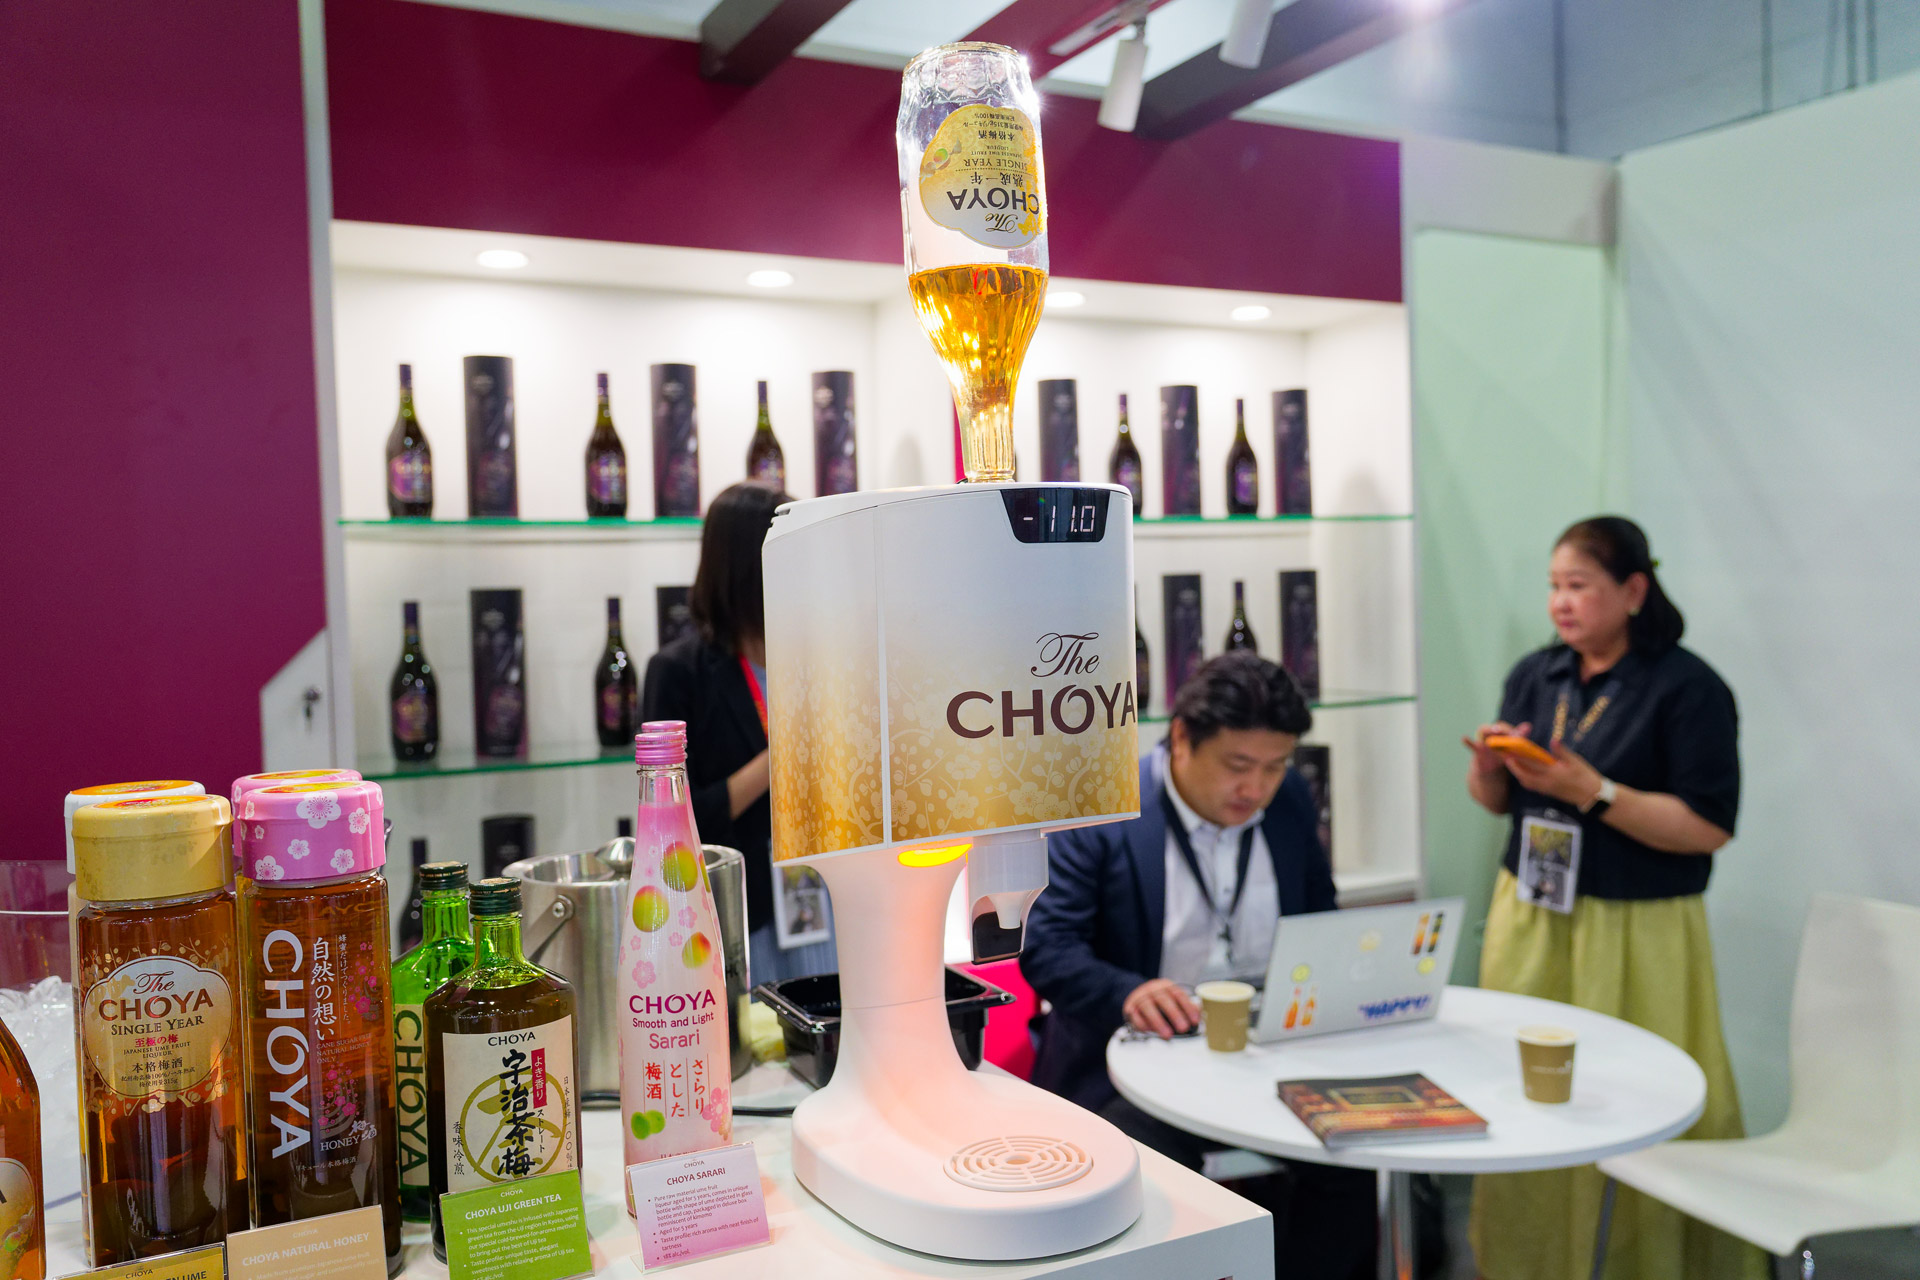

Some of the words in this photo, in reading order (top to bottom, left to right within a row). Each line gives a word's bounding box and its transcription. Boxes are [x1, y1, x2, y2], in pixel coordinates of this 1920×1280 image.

[963, 158, 991, 168] YEAR
[969, 171, 1024, 188] 熟成一年
[946, 187, 1039, 215] CHOYA
[984, 212, 1018, 233] The
[1030, 632, 1100, 678] The
[946, 680, 1137, 739] CHOYA
[133, 970, 175, 994] The
[310, 937, 337, 1041] 自然の想い
[98, 988, 214, 1021] CHOYA
[629, 989, 716, 1014] CHOYA
[111, 1022, 161, 1036] SINGLE
[166, 1016, 205, 1031] YEAR
[632, 1017, 667, 1029] Smooth
[670, 1016, 689, 1028] and
[692, 1011, 714, 1025] Light
[263, 929, 311, 1159] CHOYA
[487, 1031, 536, 1047] CHOYA
[649, 1029, 700, 1049] Sarari
[123, 1047, 153, 1055] JAPANESE
[132, 1057, 183, 1073] 本格梅酒
[395, 1009, 428, 1173] CHOYA
[645, 1062, 663, 1100] 梅酒
[670, 1063, 685, 1118] とした
[692, 1059, 706, 1116] さらり
[497, 1048, 536, 1177] 宇治茶梅
[536, 1109, 545, 1153] ストレート
[320, 1134, 360, 1152] HONEY
[667, 1174, 695, 1185] CHOYA
[697, 1168, 725, 1179] SARARI
[500, 1189, 523, 1198] CHOYA
[716, 1194, 735, 1202] depicted
[466, 1207, 496, 1219] CHOYA
[499, 1204, 511, 1212] UJI
[514, 1198, 542, 1209] GREEN
[544, 1194, 561, 1202] TEA
[694, 1205, 716, 1214] packaged
[479, 1224, 496, 1232] special
[658, 1218, 686, 1227] reminiscent
[479, 1239, 496, 1248] special
[557, 1222, 576, 1230] method
[243, 1252, 279, 1266] CHOYA
[282, 1242, 331, 1257] NATURAL
[334, 1233, 368, 1247] HONEY
[662, 1243, 681, 1251] tartness
[513, 1257, 533, 1265] relaxing
[125, 1269, 153, 1279] CHOYA
